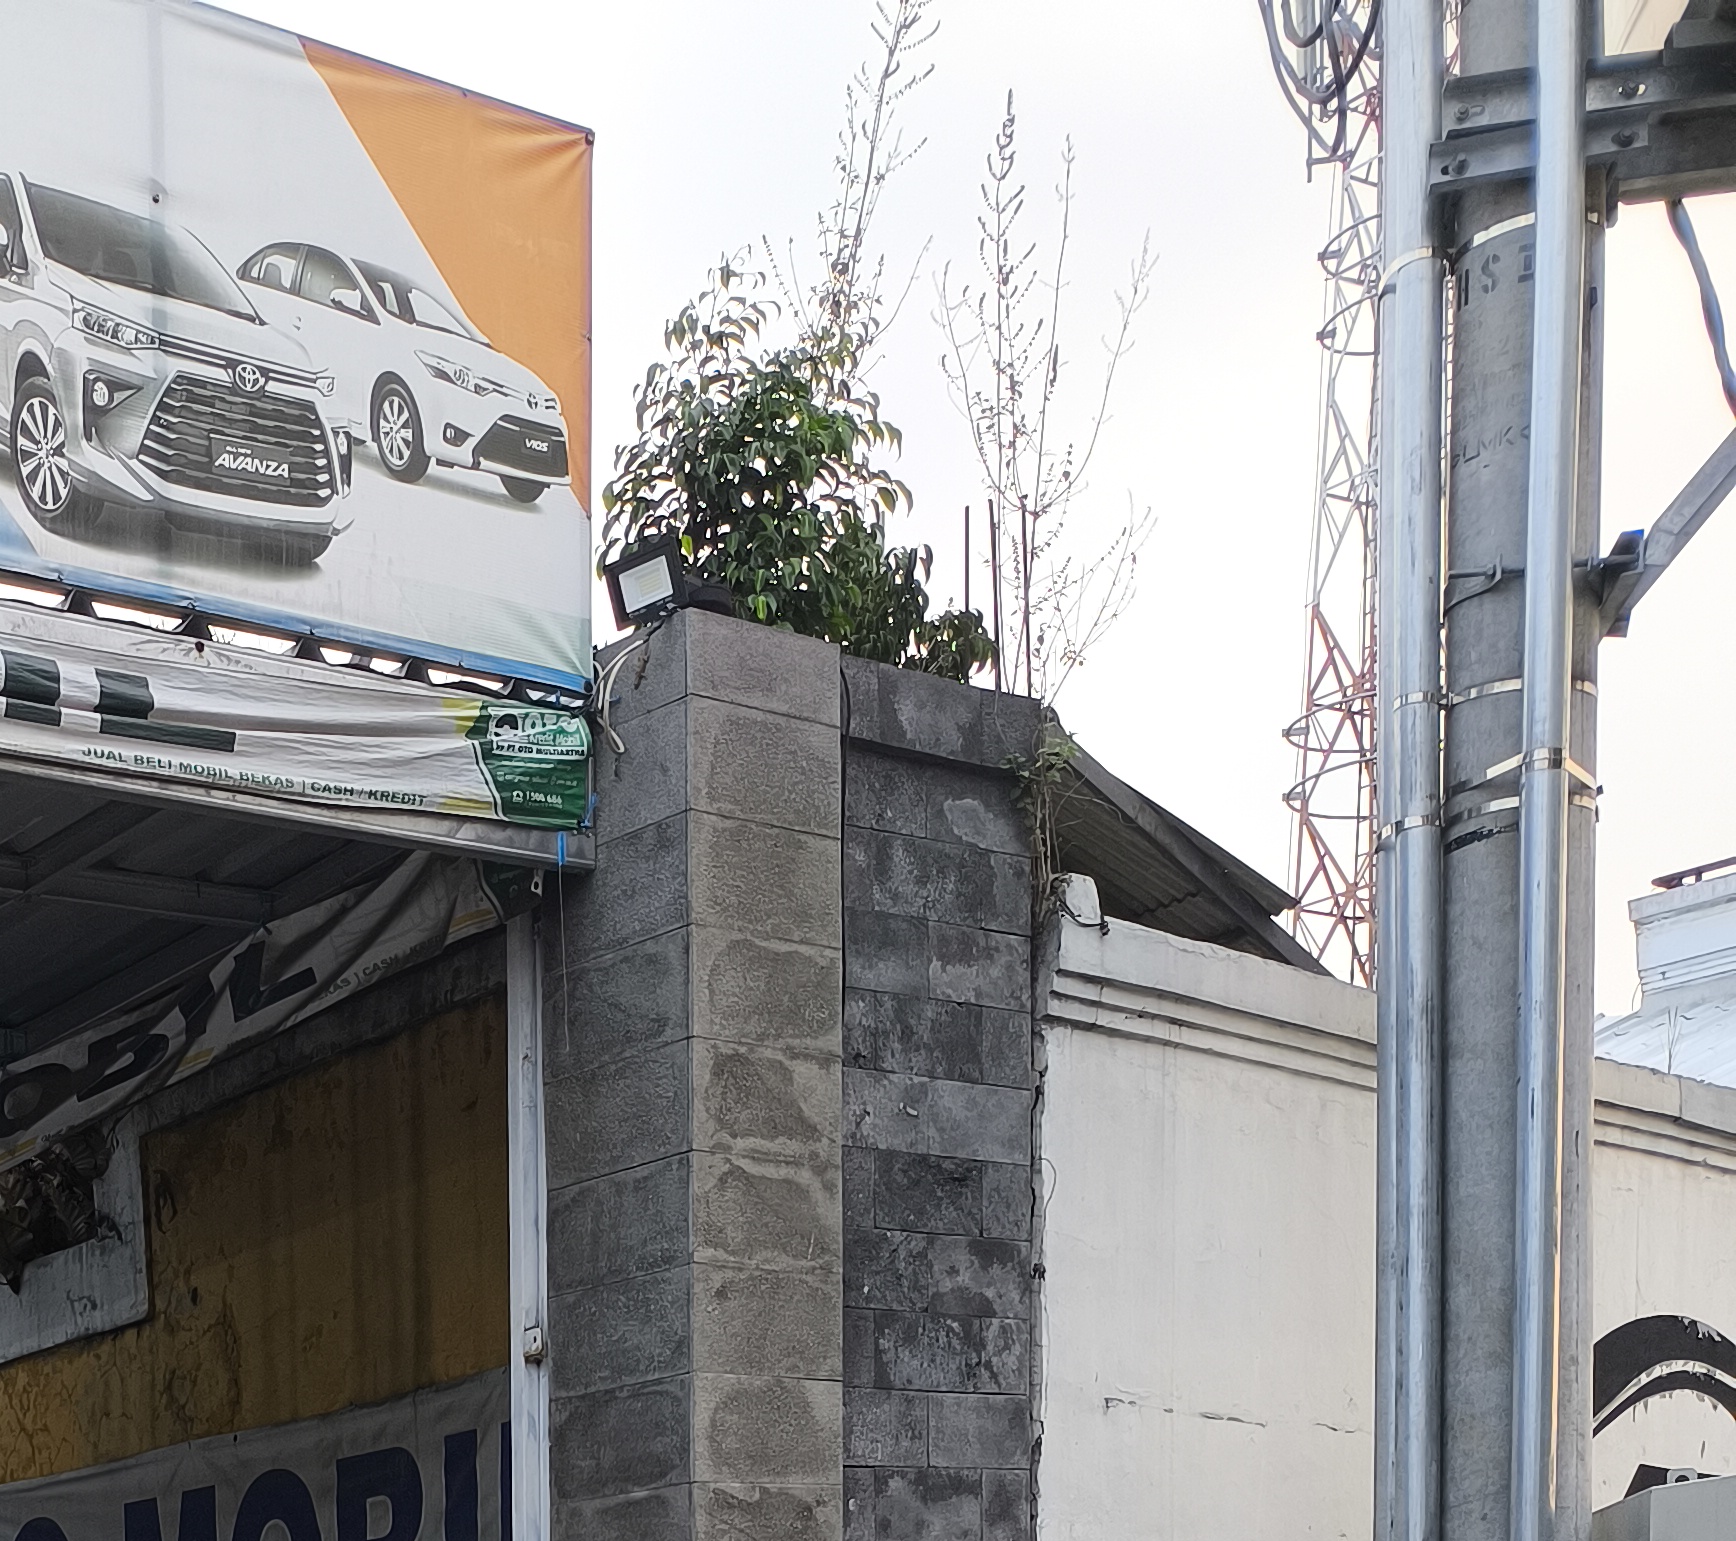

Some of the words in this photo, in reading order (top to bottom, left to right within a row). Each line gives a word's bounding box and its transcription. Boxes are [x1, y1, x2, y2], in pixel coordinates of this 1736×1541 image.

[525, 437, 549, 453] VIOS
[214, 454, 290, 479] AVANZA
[81, 747, 128, 764] JUAL
[133, 754, 173, 771] BELI
[178, 762, 235, 782] MOBIL
[310, 781, 355, 798] CASH
[367, 789, 429, 809] KREDIT
